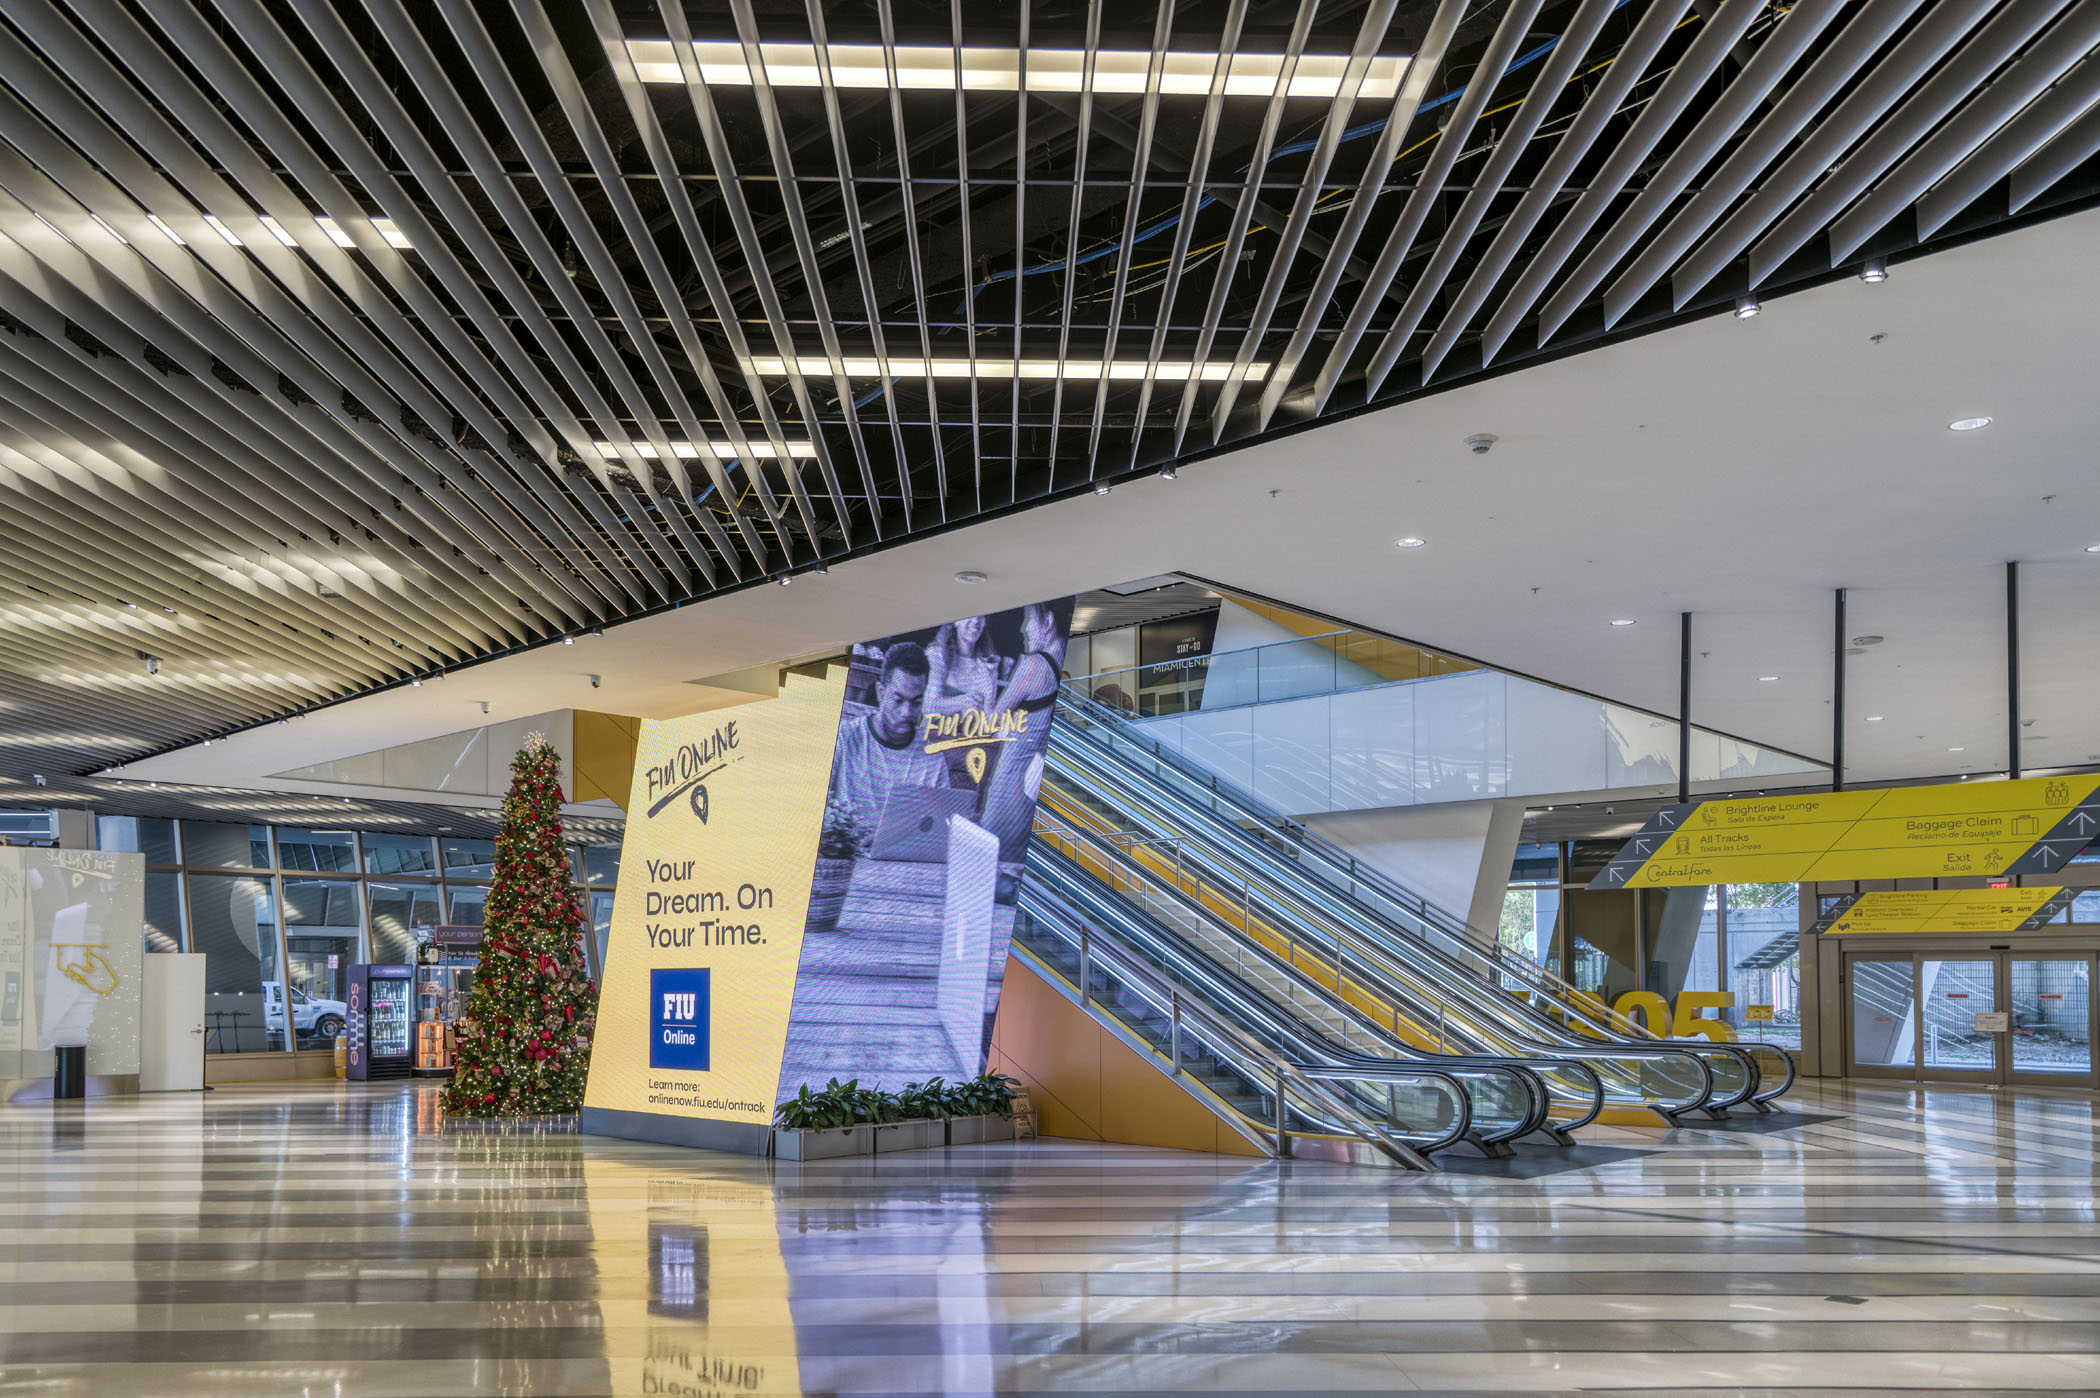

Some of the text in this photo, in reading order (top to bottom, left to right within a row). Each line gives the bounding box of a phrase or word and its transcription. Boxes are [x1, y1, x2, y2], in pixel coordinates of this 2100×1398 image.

[1177, 643, 1189, 654] STAY
[924, 707, 1028, 741] FIU ONLINE
[645, 719, 740, 801] FIU ONLINE
[1726, 801, 1820, 816] Brightline Lounge
[1727, 814, 1785, 824] Sala de Espera
[1906, 816, 2002, 831] Baggage Claim
[1700, 834, 1750, 844] All Tracks
[1907, 829, 2002, 840] Reclamo de Equipaje
[1700, 845, 1721, 853] Todas
[1946, 853, 1971, 863] Exit
[646, 859, 695, 883] Your
[1943, 863, 1971, 872] Salida
[646, 883, 773, 916] Dream. On
[646, 918, 767, 948] Your Time.
[663, 993, 696, 1020] FIU
[663, 1029, 696, 1045] Online
[648, 1078, 700, 1093] Learn more:
[648, 1093, 765, 1113] onlinenow.fiu.edu/ontrack
